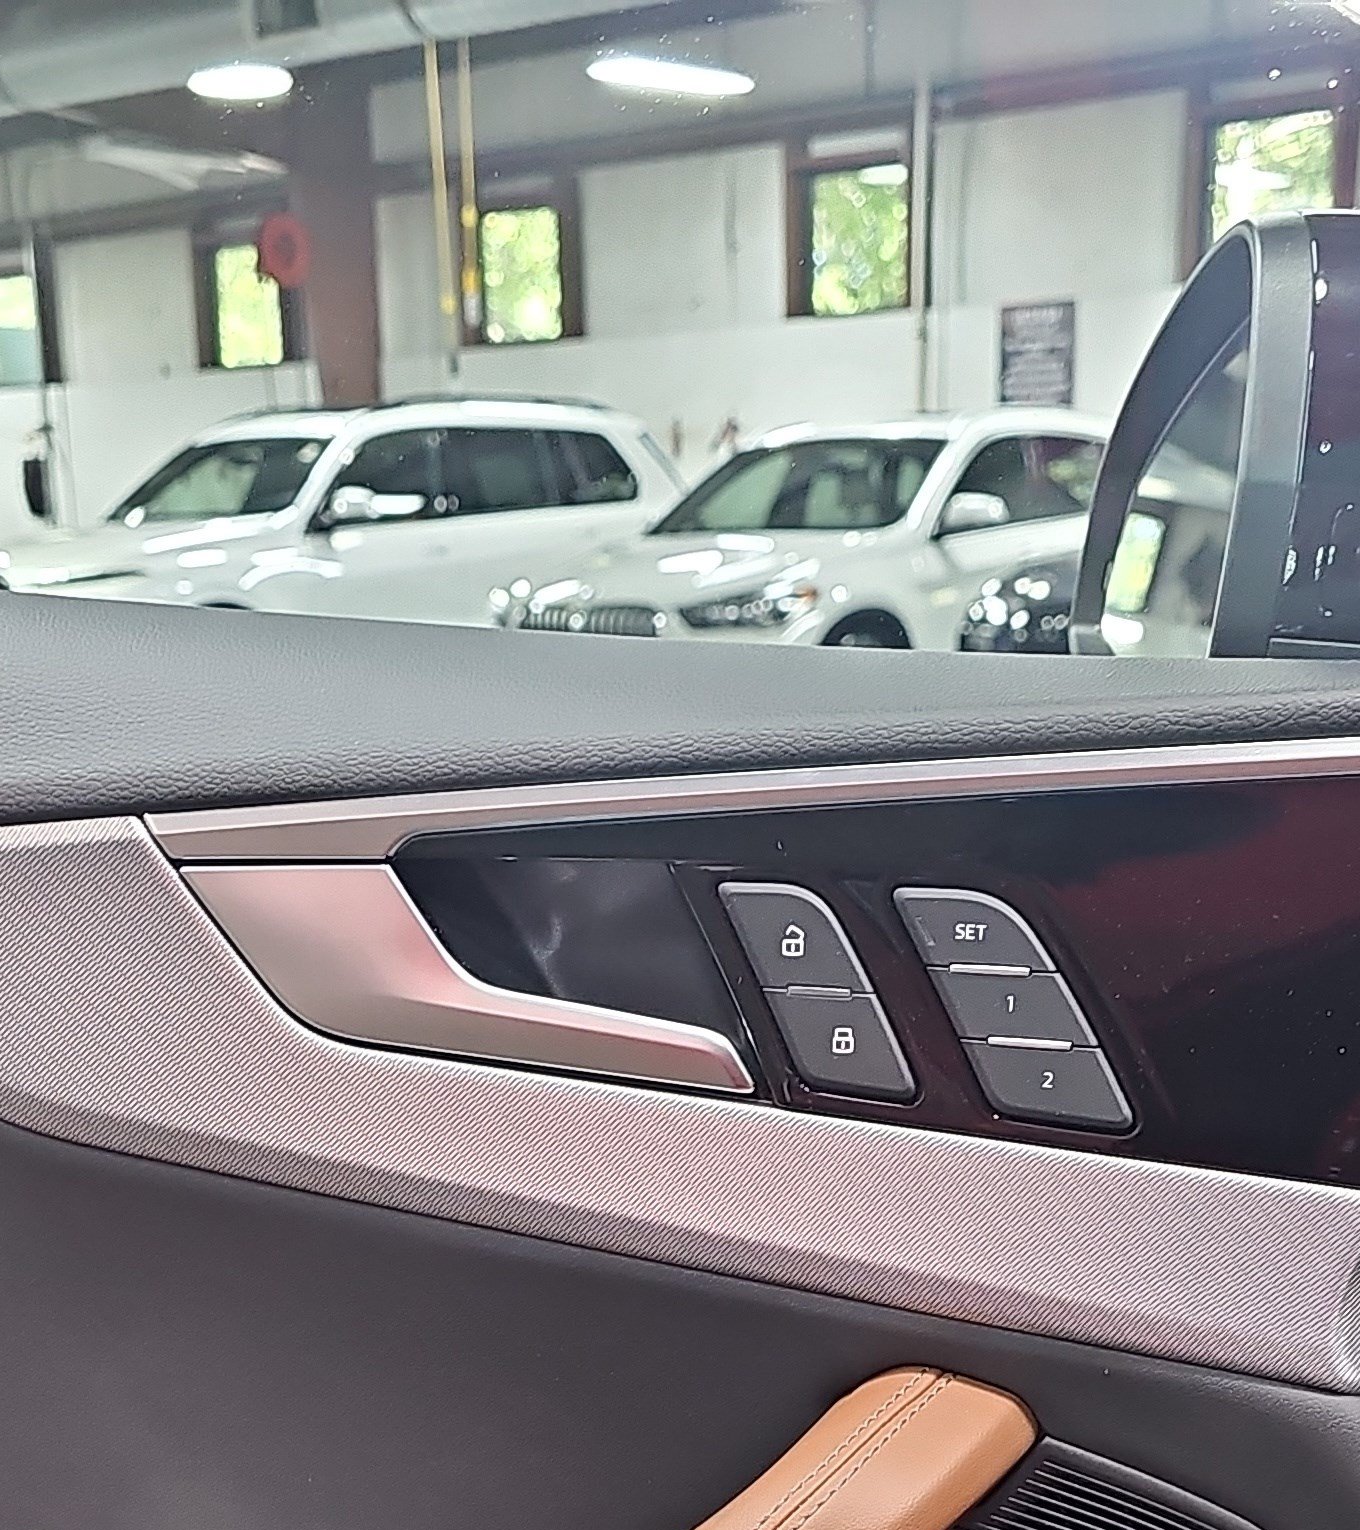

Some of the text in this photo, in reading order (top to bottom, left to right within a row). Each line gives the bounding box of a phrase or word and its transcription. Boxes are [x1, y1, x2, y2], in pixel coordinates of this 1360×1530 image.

[955, 923, 988, 941] SET
[1006, 994, 1015, 1013] 1
[1040, 1071, 1054, 1089] 2
